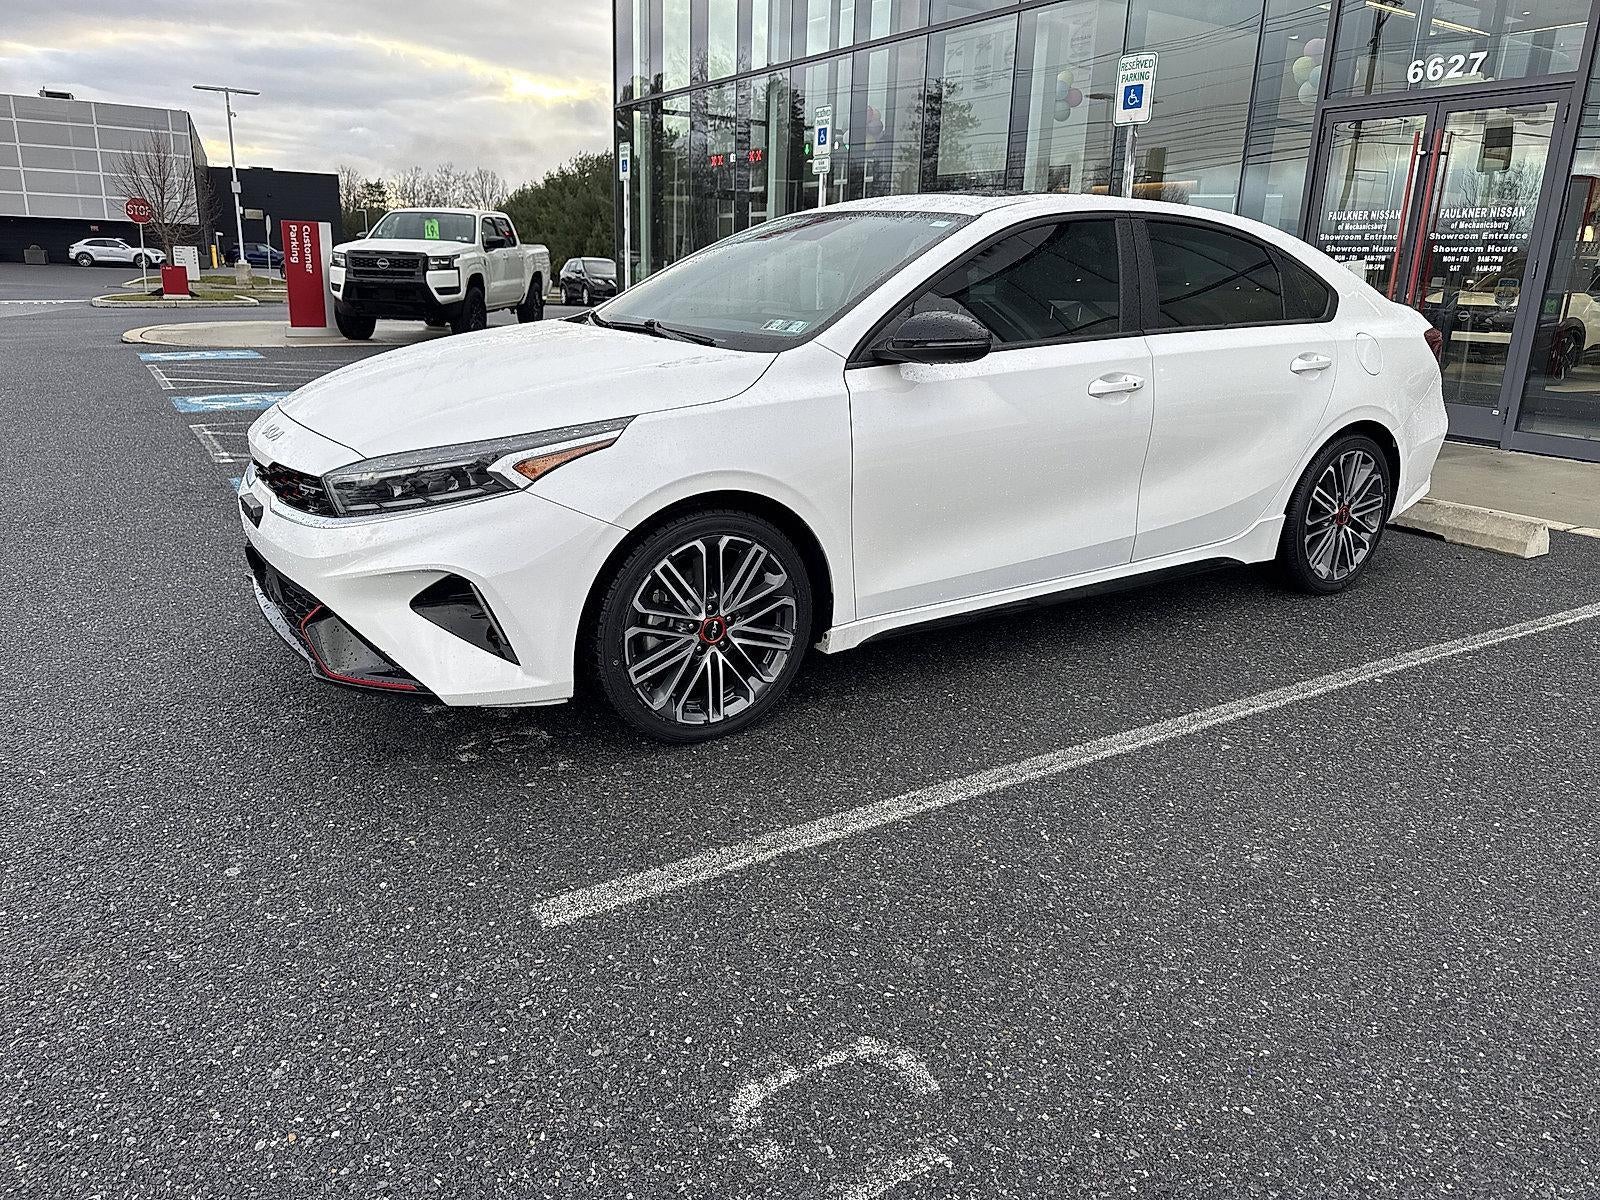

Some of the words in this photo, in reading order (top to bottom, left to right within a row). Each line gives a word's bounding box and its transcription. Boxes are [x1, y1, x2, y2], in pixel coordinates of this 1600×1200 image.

[1121, 59, 1154, 71] RESERVED
[1407, 51, 1487, 83] 6627
[1121, 71, 1150, 83] PARKING
[127, 204, 151, 216] STOP
[1328, 210, 1369, 220] FAULKNER
[1439, 207, 1487, 219] FAULKNER
[1489, 206, 1526, 218] NISSAN
[1450, 221, 1458, 229] of
[1459, 221, 1509, 230] Mechanicsburg
[1429, 232, 1479, 240] Showroom
[1482, 232, 1528, 240] Entrance
[289, 225, 300, 264] Parking
[302, 225, 313, 274] Customer
[1326, 244, 1369, 252] Showroom
[1432, 244, 1484, 253] Showroom
[1487, 244, 1518, 253] Hours
